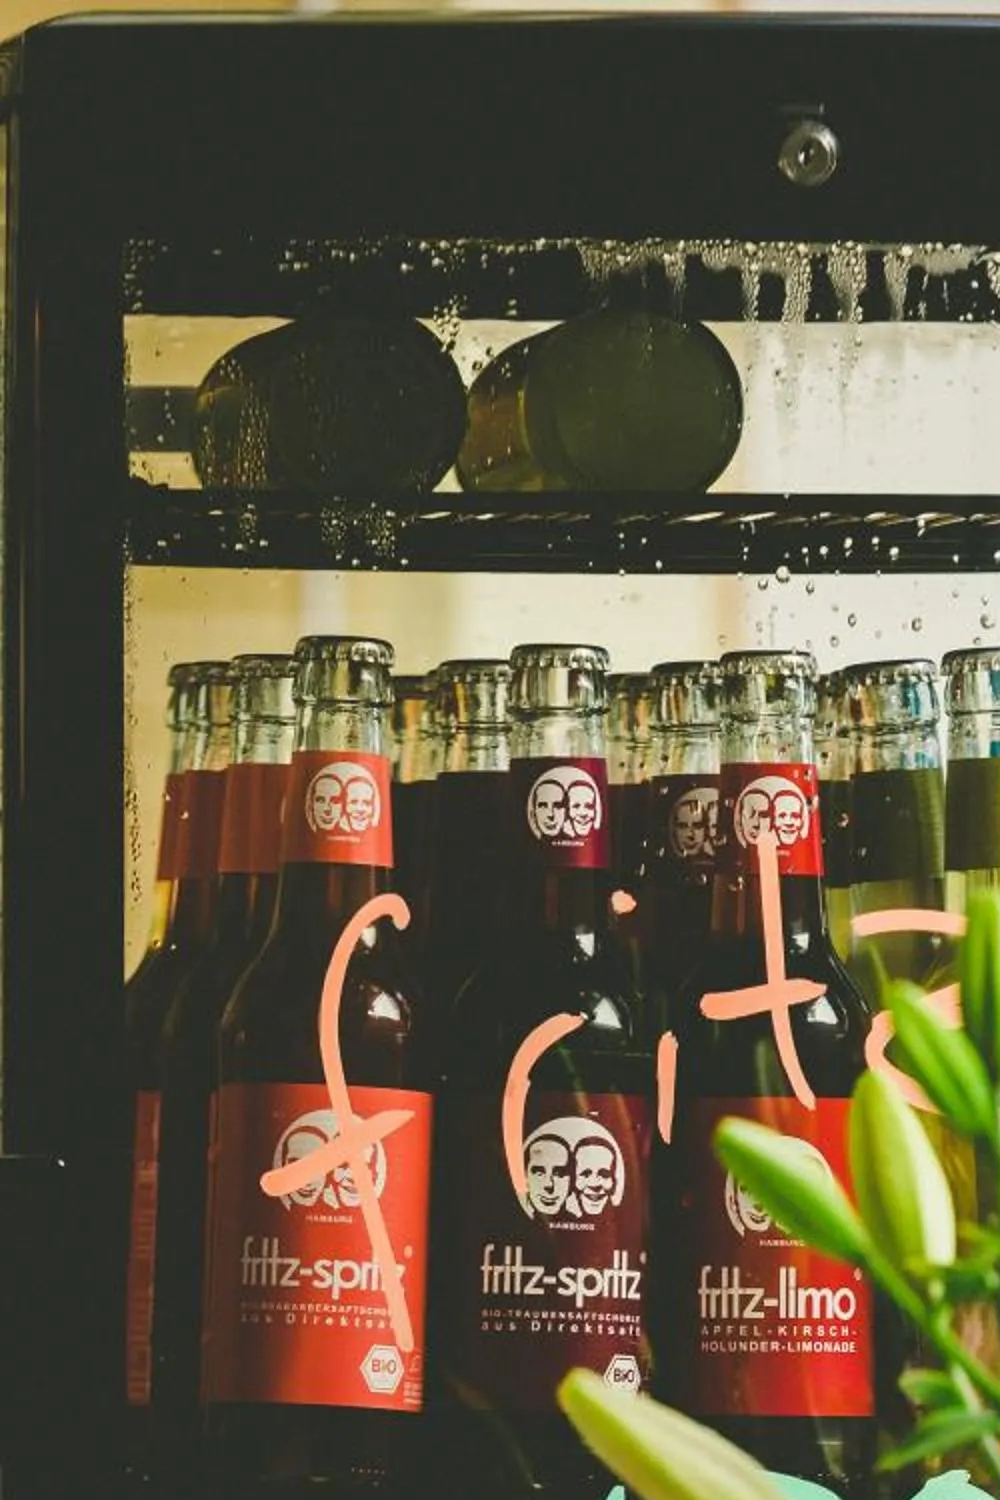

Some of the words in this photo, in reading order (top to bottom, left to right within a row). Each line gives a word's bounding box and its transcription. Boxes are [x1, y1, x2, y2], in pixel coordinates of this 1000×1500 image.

[480, 1243, 641, 1309] fritz-spritz
[698, 1264, 856, 1321] fritz-limo
[701, 1340, 856, 1353] HOLUNDER-LIMONADE
